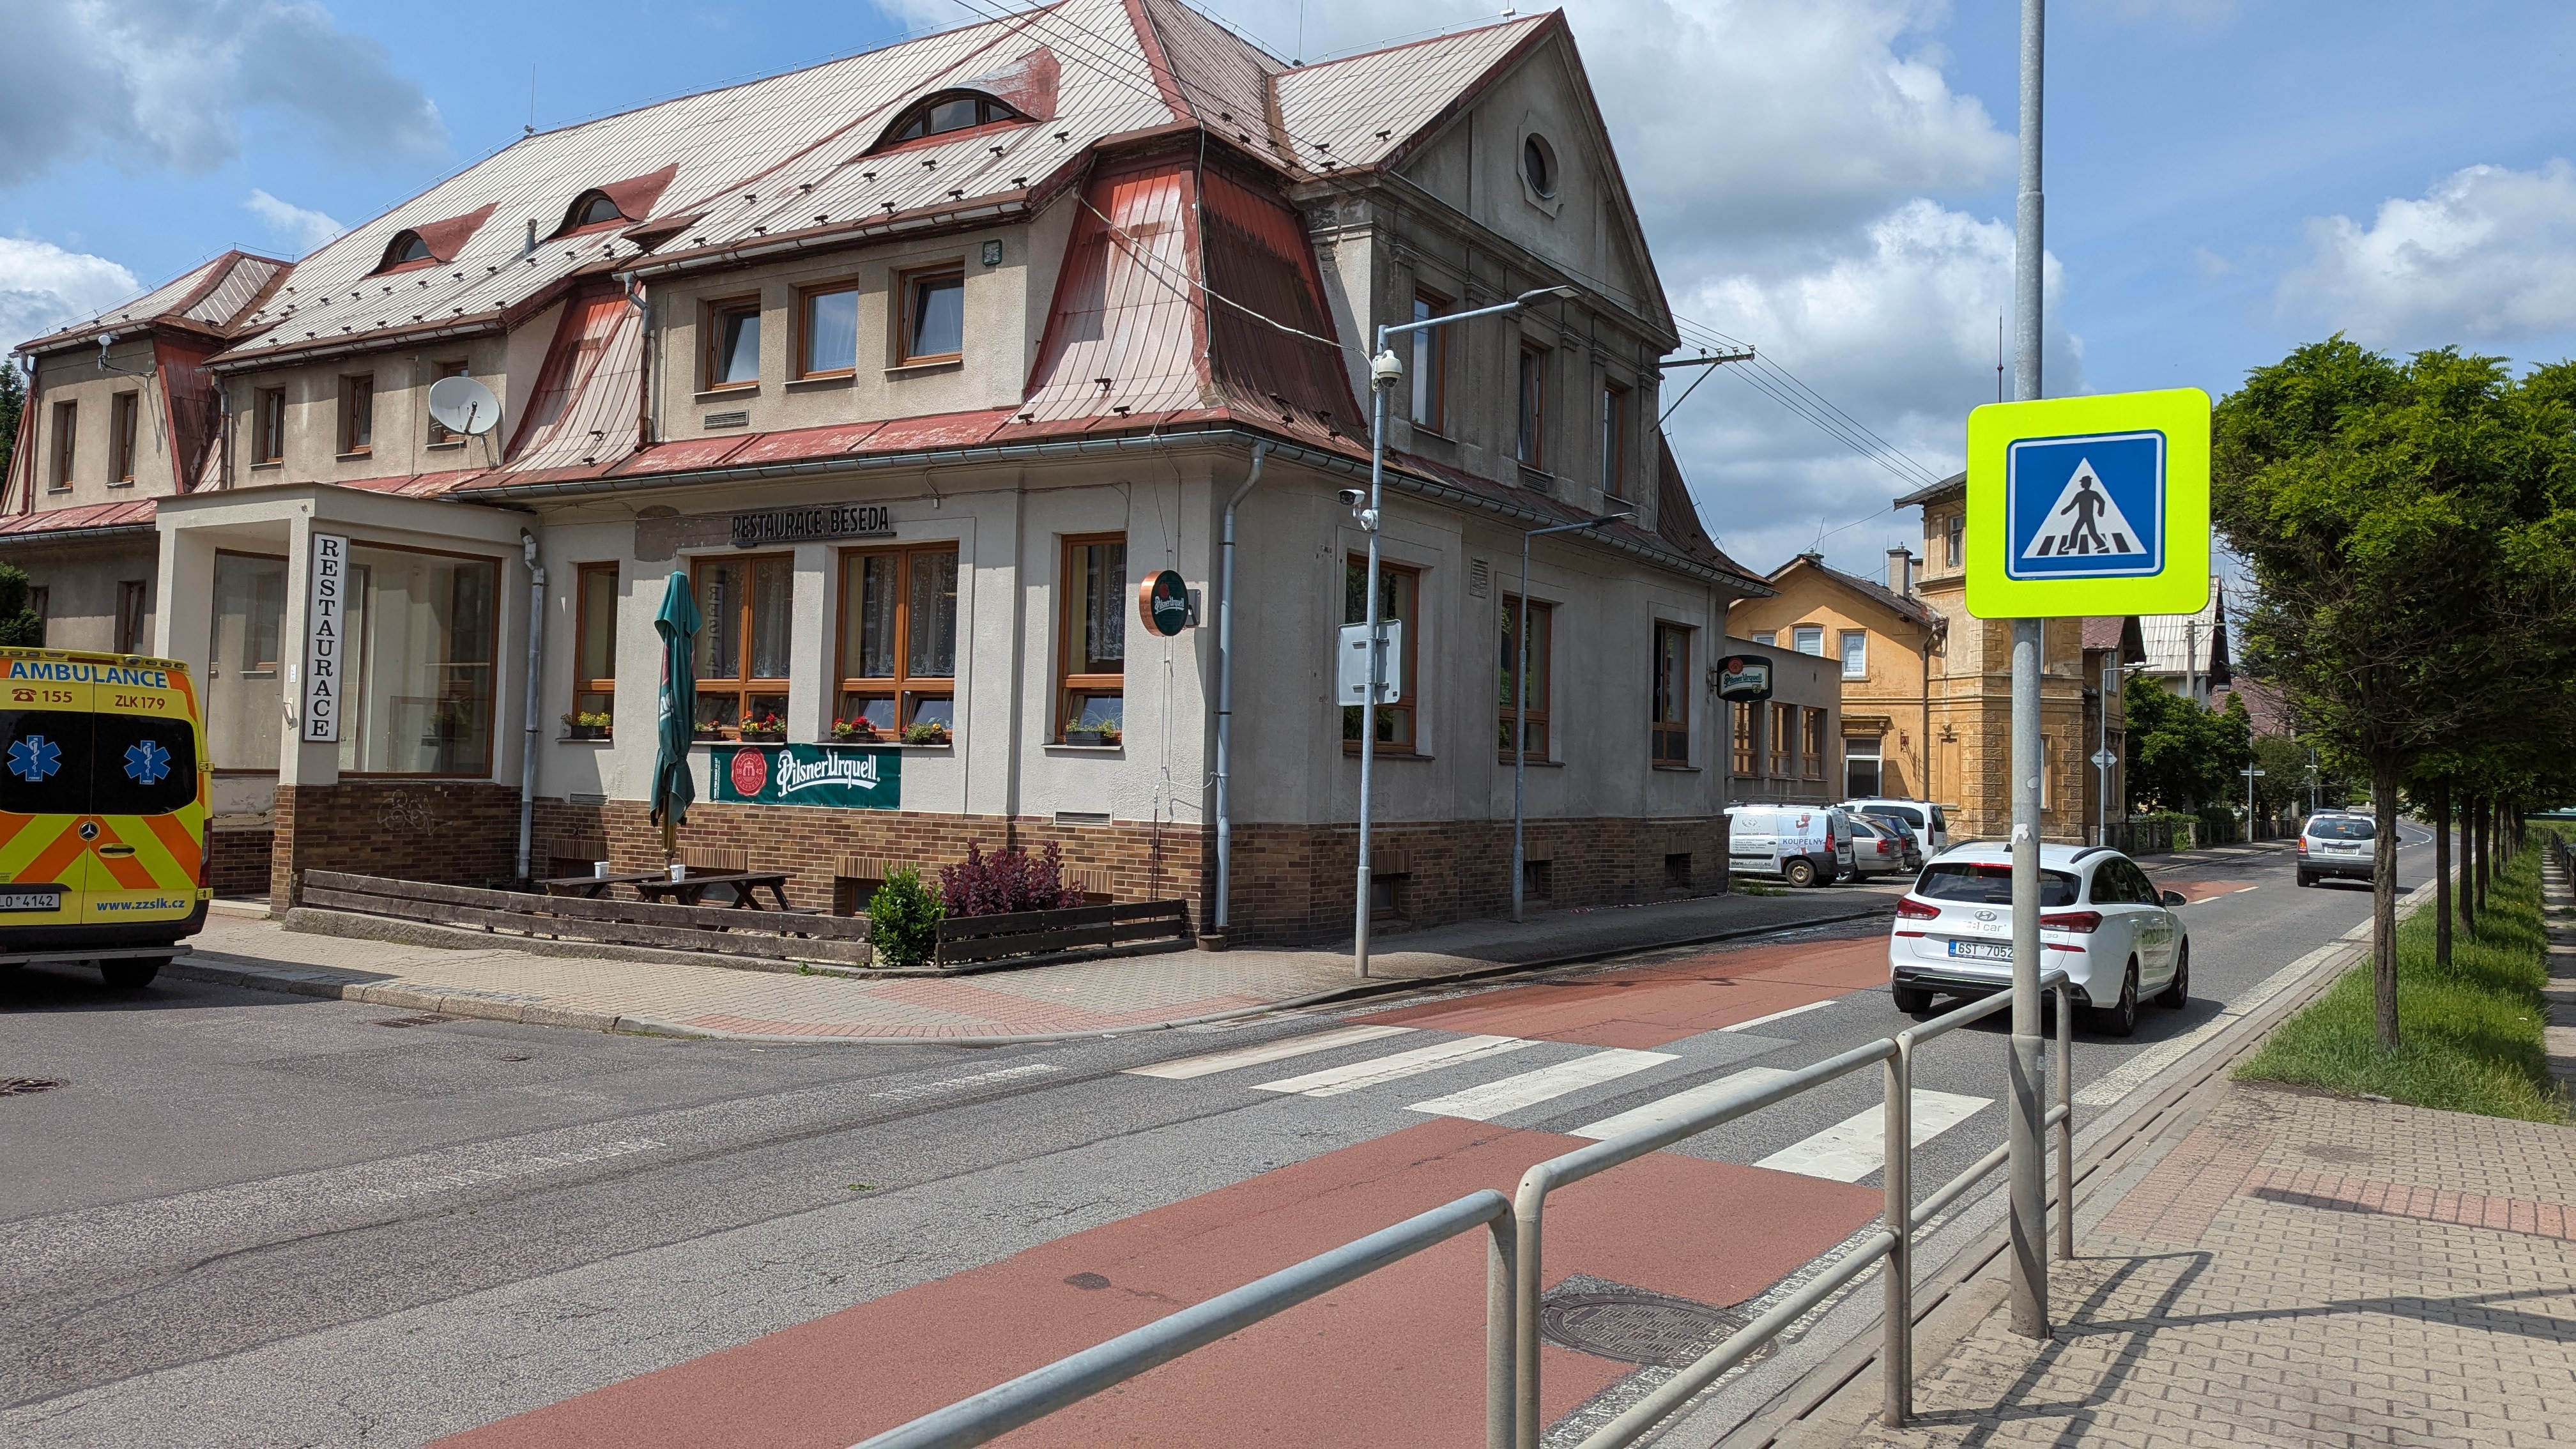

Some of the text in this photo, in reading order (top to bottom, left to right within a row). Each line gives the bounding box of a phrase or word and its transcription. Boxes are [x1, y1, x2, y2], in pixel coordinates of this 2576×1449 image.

[732, 507, 889, 539] RESTAURACE BESEDA
[1154, 595, 1170, 614] Pilsner
[310, 539, 339, 737] RESTAURACE
[10, 662, 167, 688] AMBULANCE
[1724, 673, 1743, 687] Pilsner
[42, 691, 72, 703] 155
[115, 694, 165, 710] ZLK 179
[777, 747, 877, 797] Pilsner Urquell
[23, 896, 53, 907] 4142
[96, 897, 185, 911] www.zzslk.cz
[1958, 943, 2013, 958] 6ST 7052
